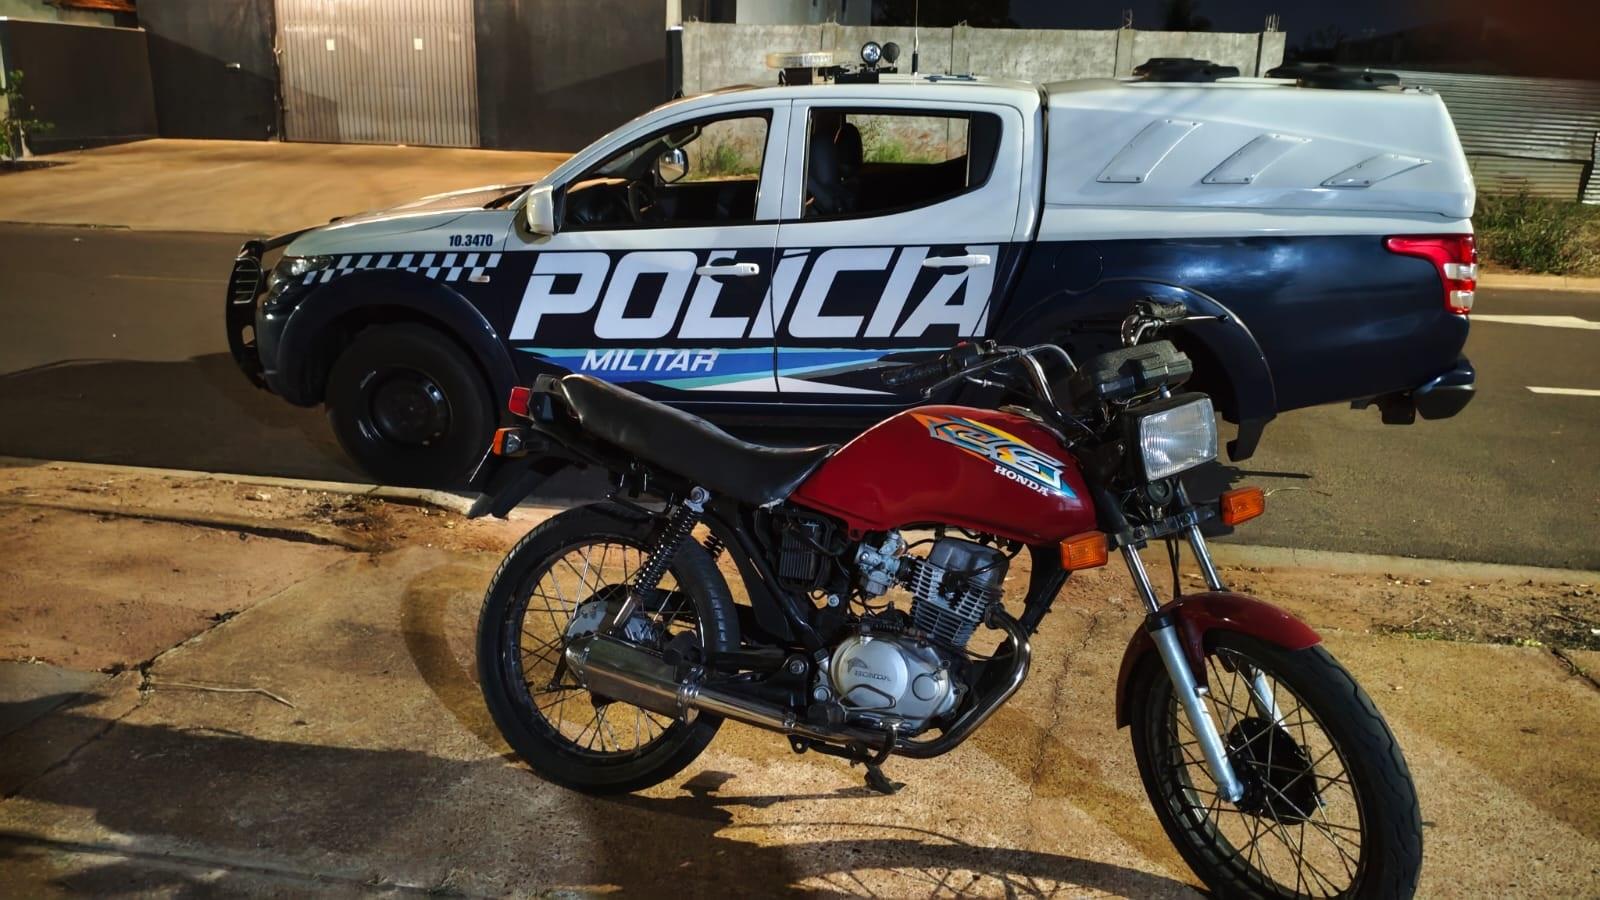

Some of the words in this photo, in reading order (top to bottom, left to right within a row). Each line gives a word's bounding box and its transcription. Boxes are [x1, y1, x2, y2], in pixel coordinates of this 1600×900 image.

[449, 234, 493, 247] 10.3470
[581, 348, 719, 372] MILITAR
[994, 464, 1049, 497] HONDA
